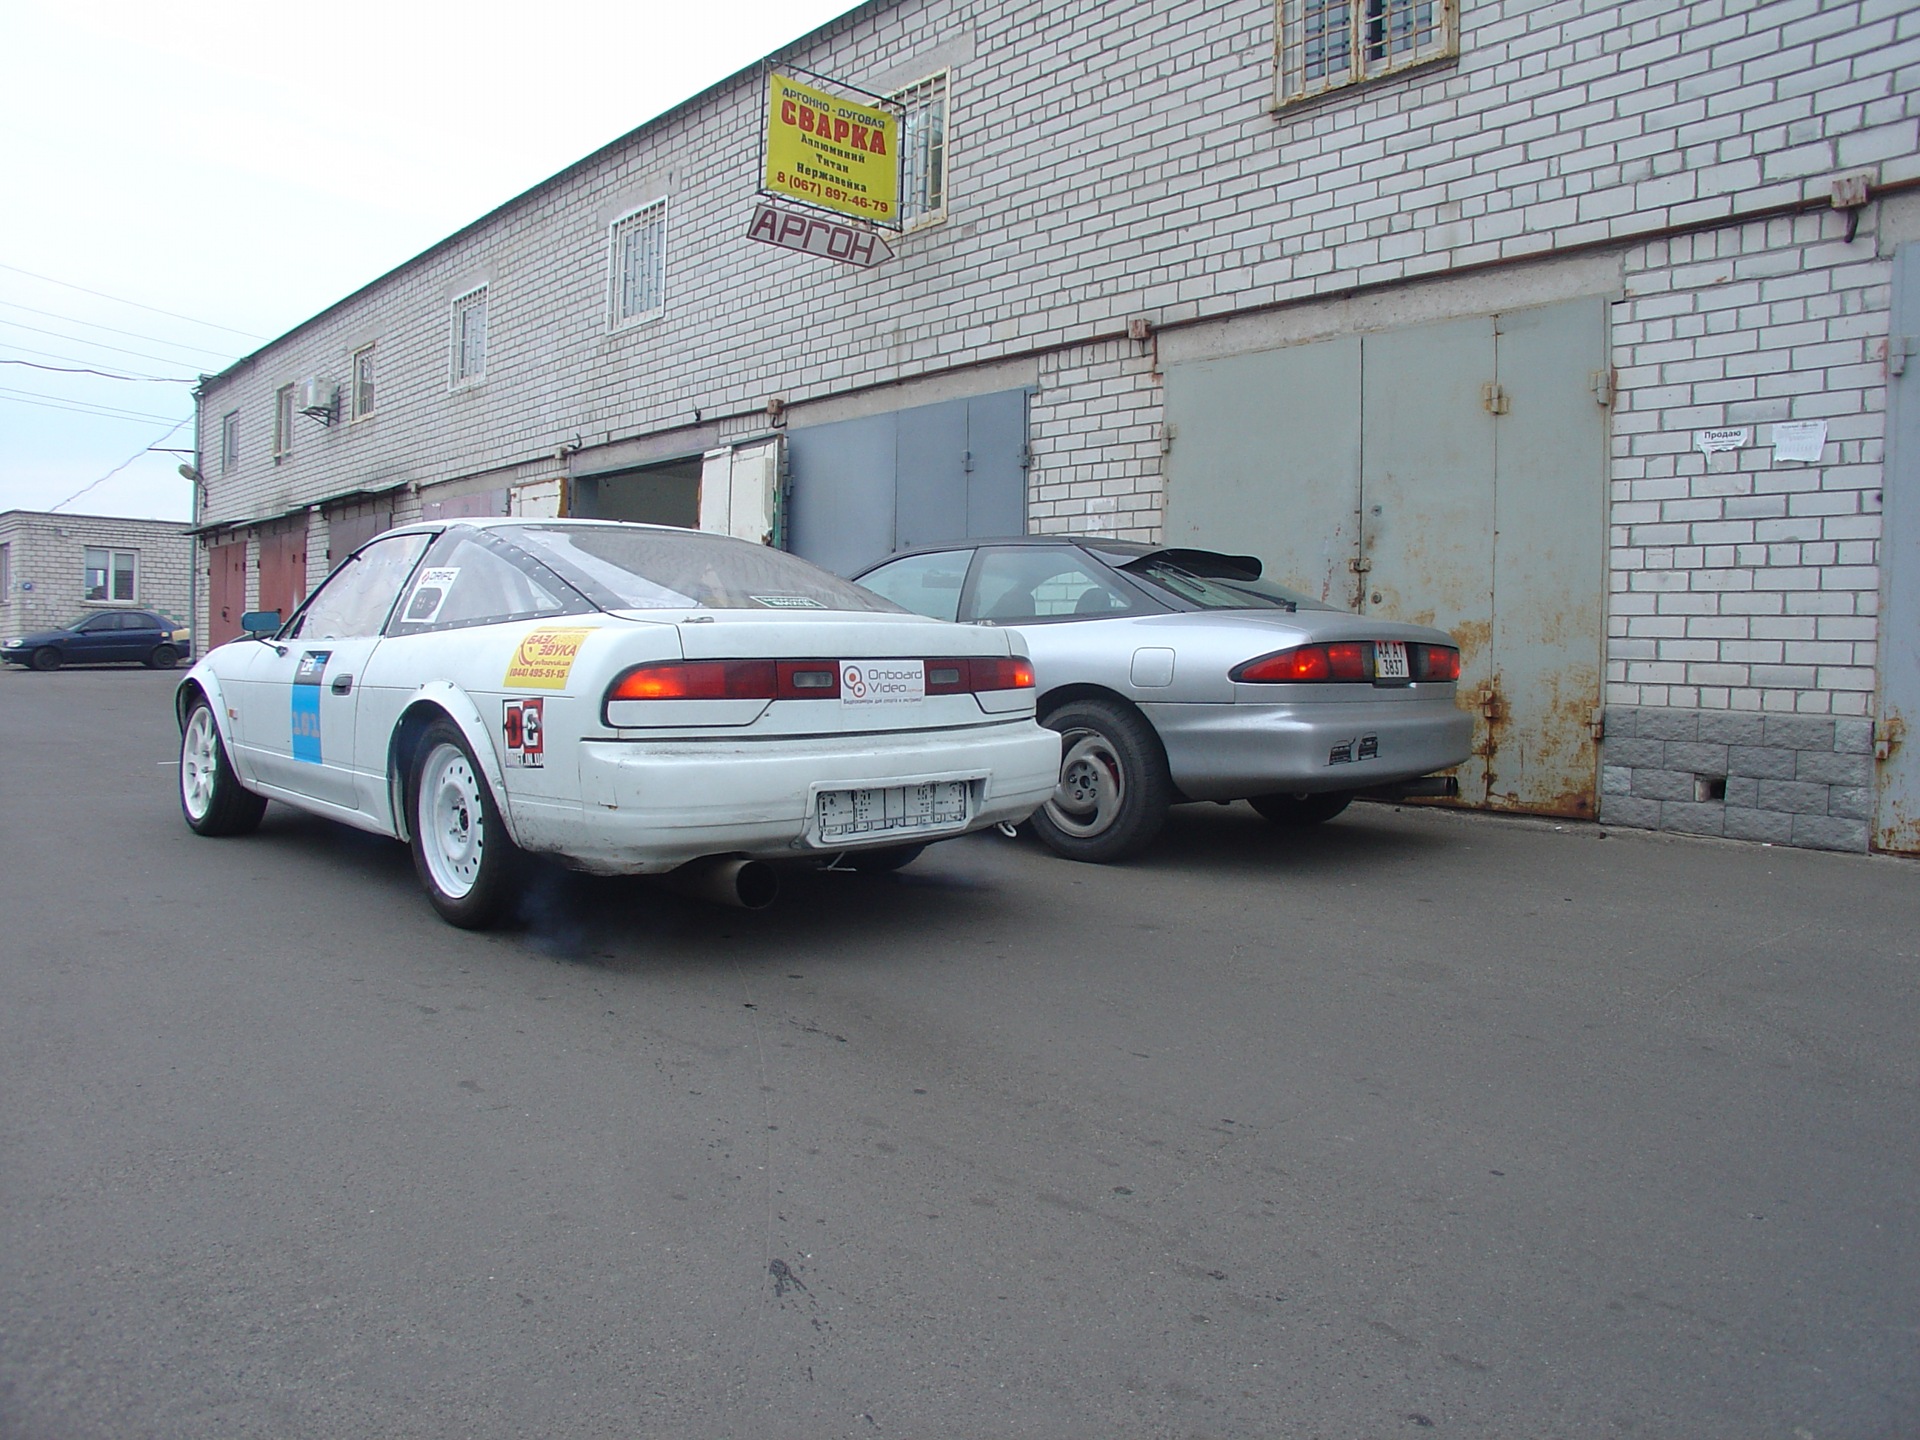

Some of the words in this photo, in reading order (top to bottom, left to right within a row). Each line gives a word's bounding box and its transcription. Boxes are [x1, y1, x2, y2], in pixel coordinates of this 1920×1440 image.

[782, 87, 830, 112] АРГОННО
[838, 108, 885, 130] ДУГОВАЯ
[781, 99, 887, 156] СВАРКА
[816, 153, 849, 174] Титан
[796, 162, 867, 193] Нержавейка
[777, 171, 786, 183] 8
[789, 175, 821, 197] (067)
[825, 186, 889, 213] 897-46-79
[751, 209, 876, 265] АРГОН
[1704, 430, 1742, 440] Продаю
[538, 644, 577, 656] ЗВУКА
[529, 668, 566, 678] 495-51-15
[868, 669, 923, 680] Onboard
[868, 682, 907, 693] Video
